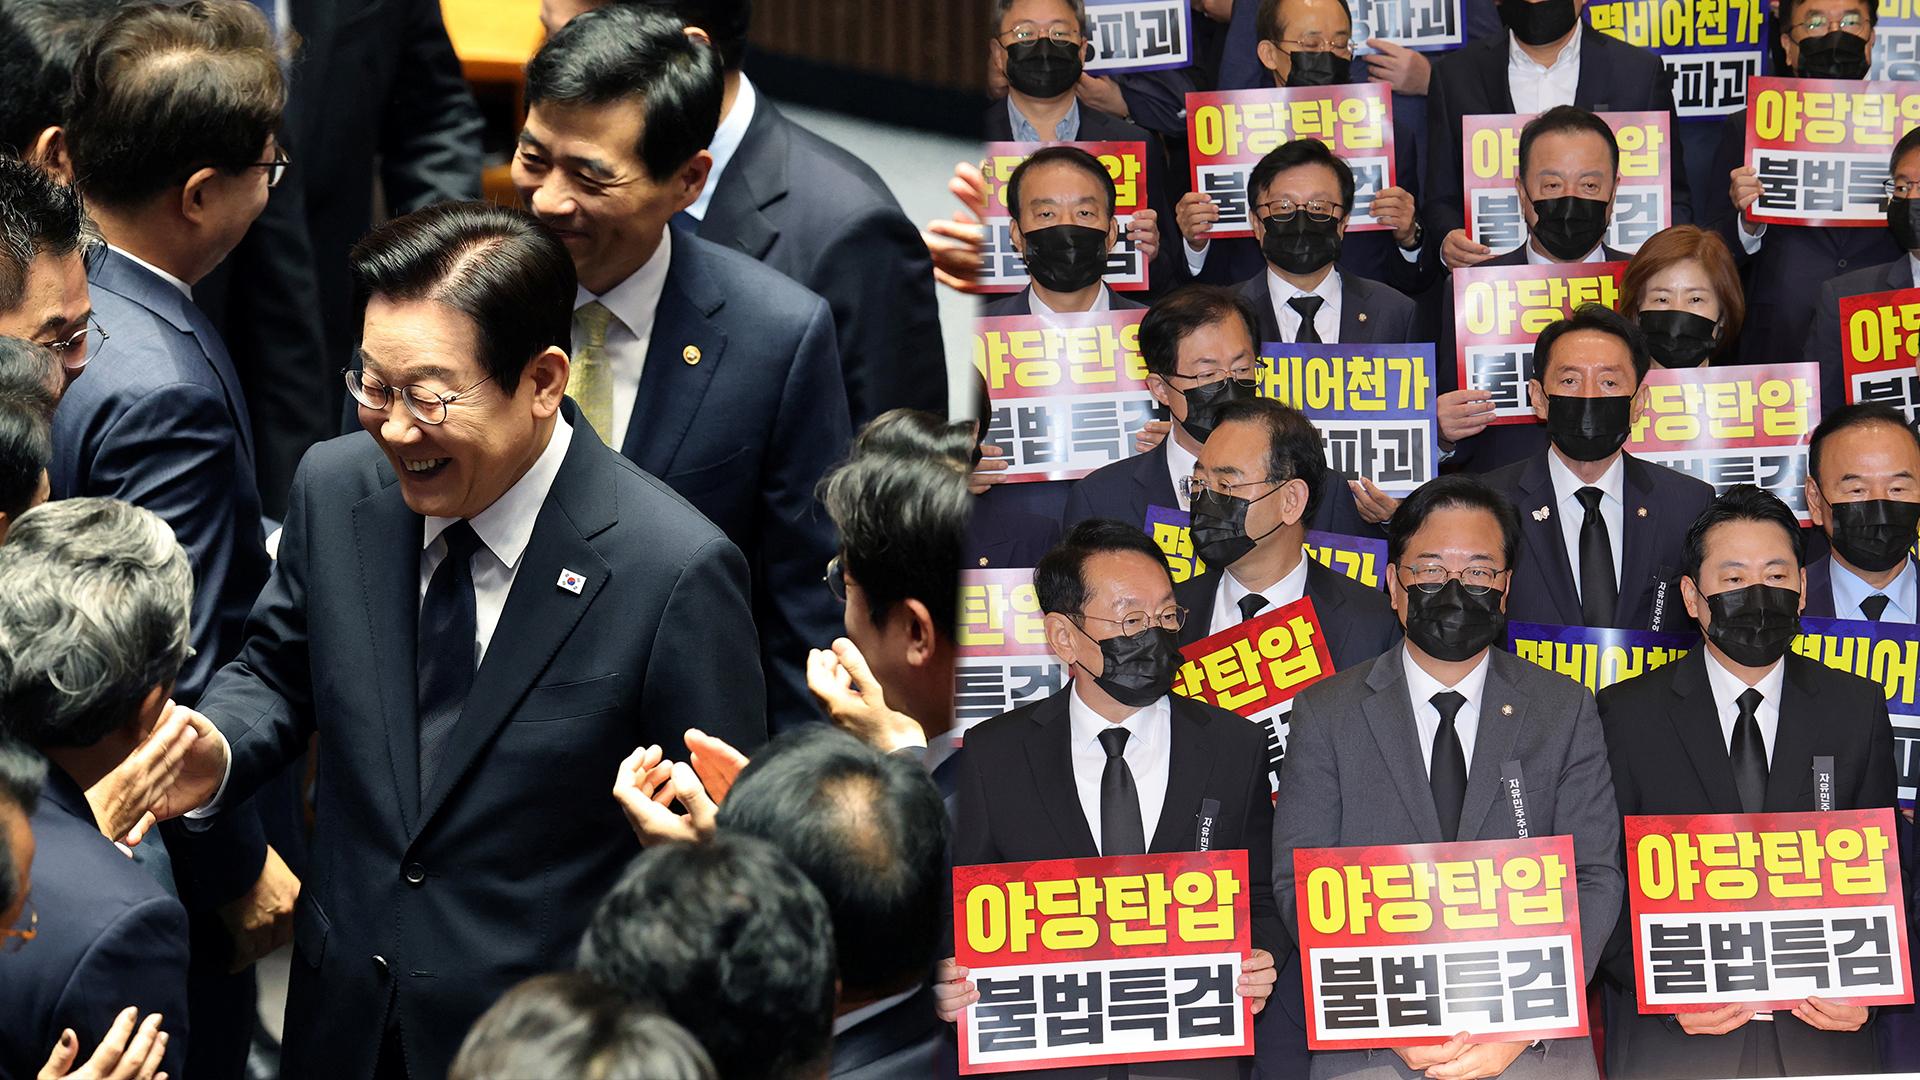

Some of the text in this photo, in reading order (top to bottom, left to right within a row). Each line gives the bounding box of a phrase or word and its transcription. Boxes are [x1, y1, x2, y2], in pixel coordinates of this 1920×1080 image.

[1195, 97, 1386, 156] 야당탄압
[1758, 157, 1891, 212] 불법특
[1465, 275, 1619, 335] 야당탄
[1255, 356, 1430, 411] 비어천가
[1314, 428, 1425, 483] 파괴
[1509, 778, 1529, 839] 자유민주주의
[1306, 854, 1567, 935] 야당탄압
[1637, 826, 1889, 901] 야당탄압
[966, 869, 1240, 953] 야당탄압
[1320, 946, 1570, 1029] 불법특검
[1649, 916, 1894, 994] 불법특검
[976, 964, 1236, 1053] 불법특검
